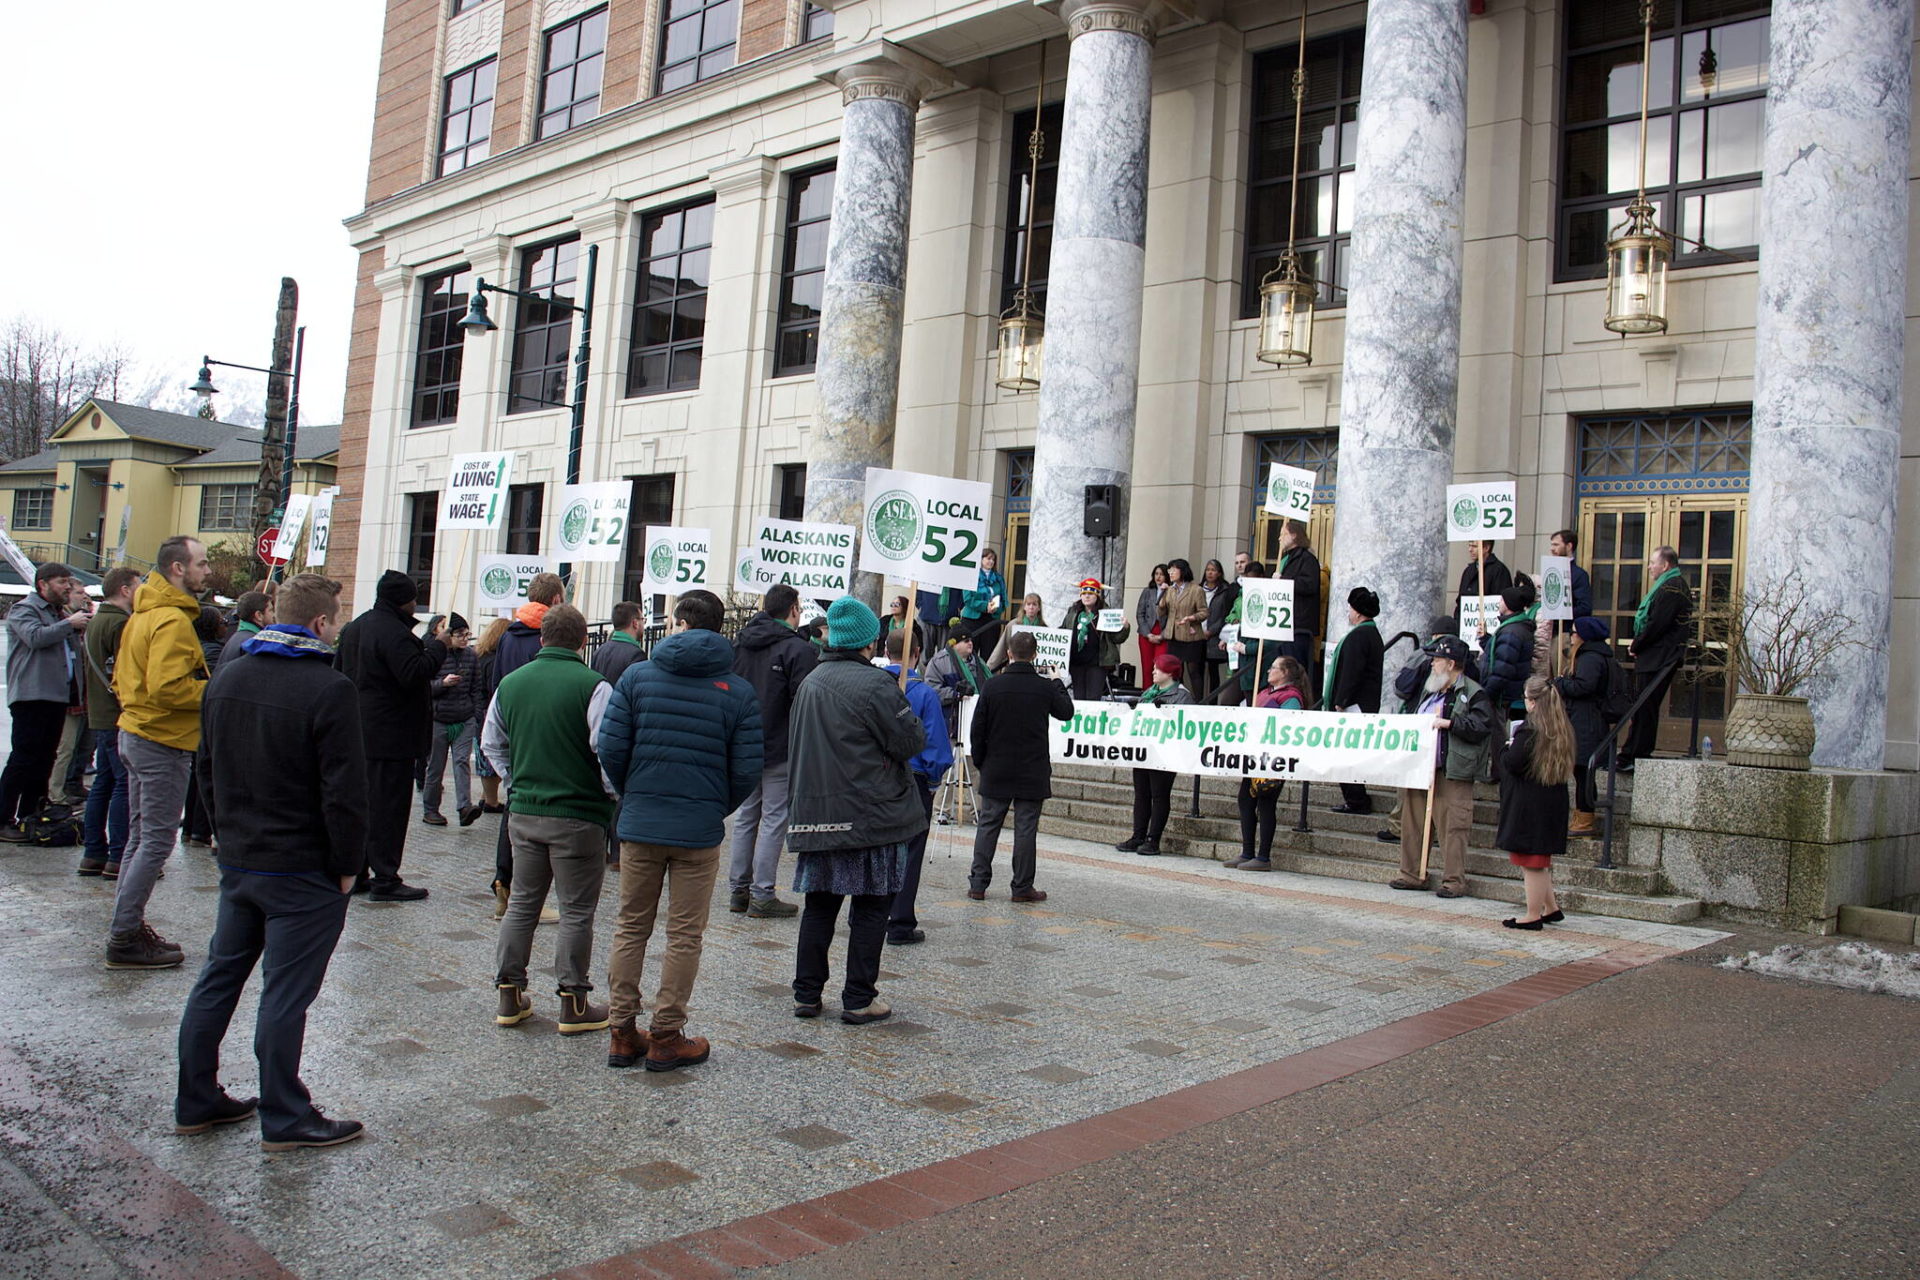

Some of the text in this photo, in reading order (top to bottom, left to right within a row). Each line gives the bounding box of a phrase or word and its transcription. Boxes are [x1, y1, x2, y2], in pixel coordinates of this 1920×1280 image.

[463, 460, 491, 470] COST OF
[453, 470, 496, 488] LIVING
[1292, 477, 1312, 491] LOCAL
[460, 493, 480, 502] STATE
[594, 498, 628, 510] LAL
[1290, 490, 1310, 512] 52
[1481, 494, 1514, 503] LOCAL
[450, 503, 487, 519] WAGE
[926, 499, 984, 522] LOCAL
[1483, 507, 1514, 528] 52
[588, 516, 623, 545] 52
[760, 527, 850, 548] ALASKANS
[678, 542, 708, 554] LOCAL
[890, 536, 902, 550] 52
[922, 525, 978, 569] 52
[761, 548, 846, 568] WORKING
[676, 558, 706, 584] 52
[756, 568, 845, 590] for ALASKA
[517, 578, 530, 598] 5
[1268, 591, 1292, 602] LOCAL
[1266, 606, 1292, 628] 52
[1036, 632, 1069, 644] SKANS
[1036, 646, 1066, 656] RKING
[1060, 709, 1420, 752] State Employees Association
[1063, 738, 1300, 774] Juneau Chapter
